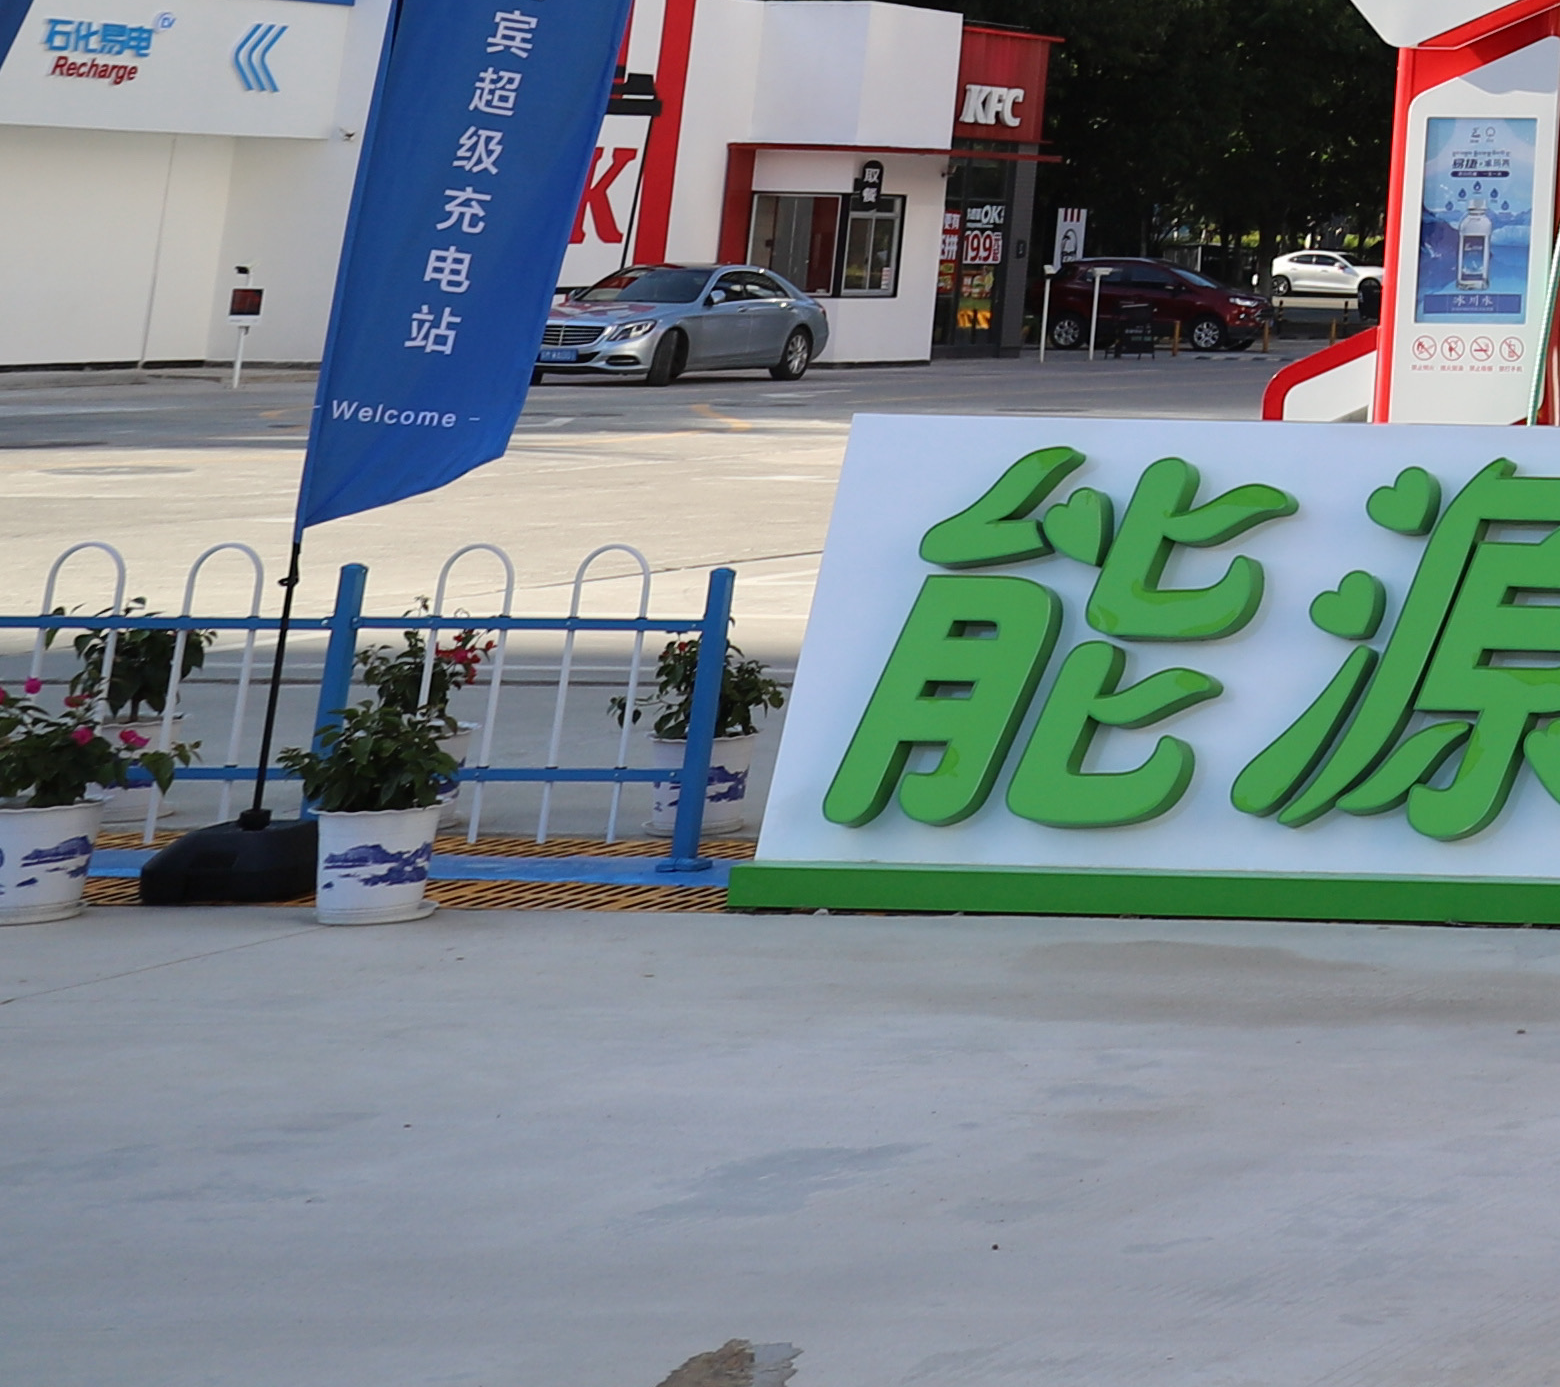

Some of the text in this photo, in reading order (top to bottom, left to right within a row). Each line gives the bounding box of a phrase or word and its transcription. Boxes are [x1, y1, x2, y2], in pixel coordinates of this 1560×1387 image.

[45, 17, 153, 58] 石化易电
[50, 55, 138, 85] Recharge
[960, 83, 1024, 127] KFC
[863, 167, 881, 204] 取餐
[1451, 294, 1494, 307] 冰川水
[331, 400, 458, 428] Welcome
